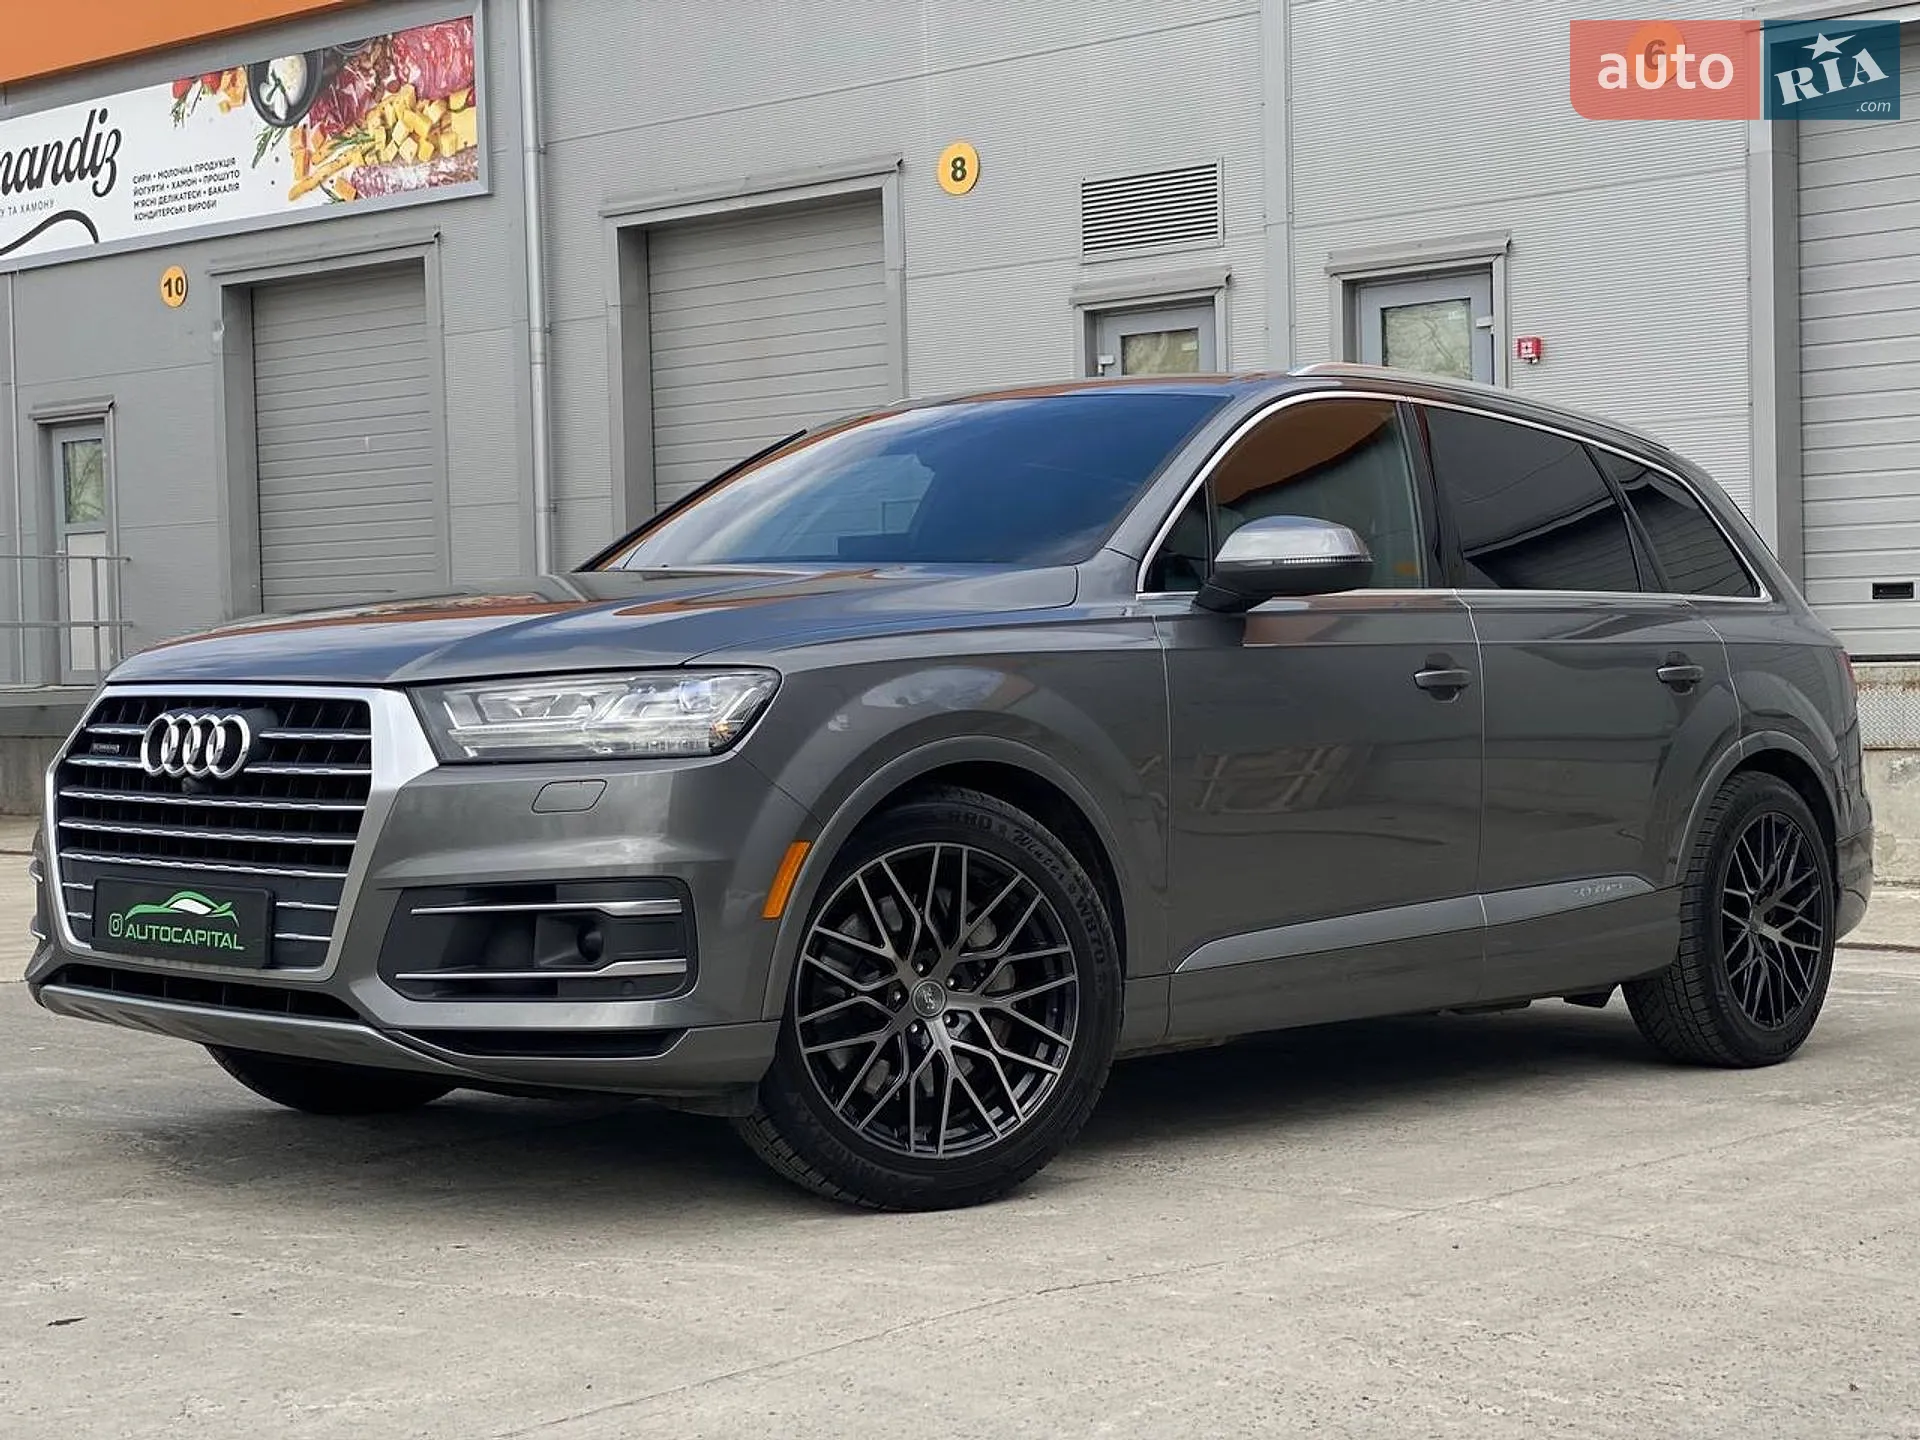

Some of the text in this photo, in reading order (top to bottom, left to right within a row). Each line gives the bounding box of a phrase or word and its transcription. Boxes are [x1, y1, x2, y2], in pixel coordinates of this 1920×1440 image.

[132, 157, 236, 185] СИРИ МОЛОЧНА ПРОДУКЦІЯ
[951, 156, 967, 182] 8
[133, 170, 240, 196] ЙОГУРТИ ХАМОН ПРОШУТО
[158, 190, 202, 205] ДЕЛІКАТЕСИ
[208, 182, 240, 196] БАКАЛІЯ
[20, 199, 55, 213] ХАМОНУ
[134, 199, 217, 221] КОНДИТЕРСЬКІ ВИРОБИ
[163, 276, 184, 298] 10
[124, 923, 245, 951] AUTOCAPITAL
